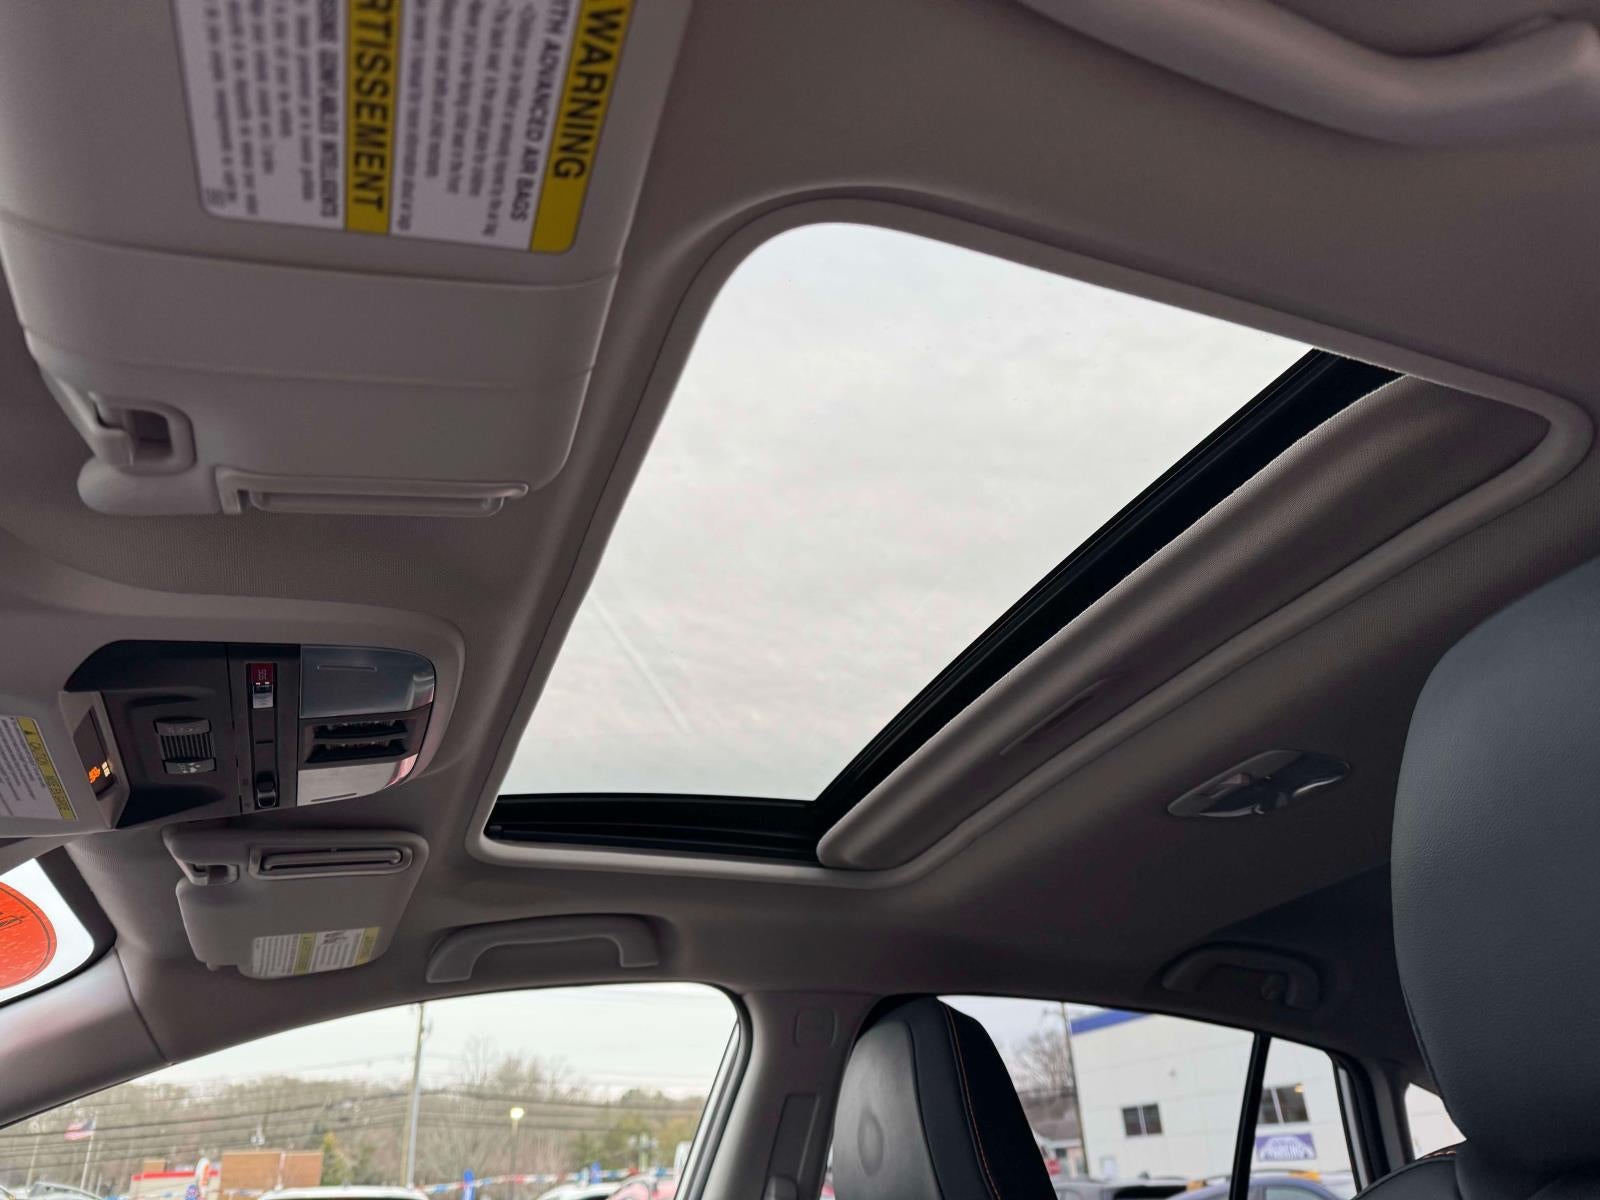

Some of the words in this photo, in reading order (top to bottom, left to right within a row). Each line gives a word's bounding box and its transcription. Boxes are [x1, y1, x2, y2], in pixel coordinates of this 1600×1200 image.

[525, 38, 562, 141] ADVANCED
[555, 7, 625, 178] WARNING
[519, 145, 540, 174] AIR
[510, 177, 535, 221] BAGS
